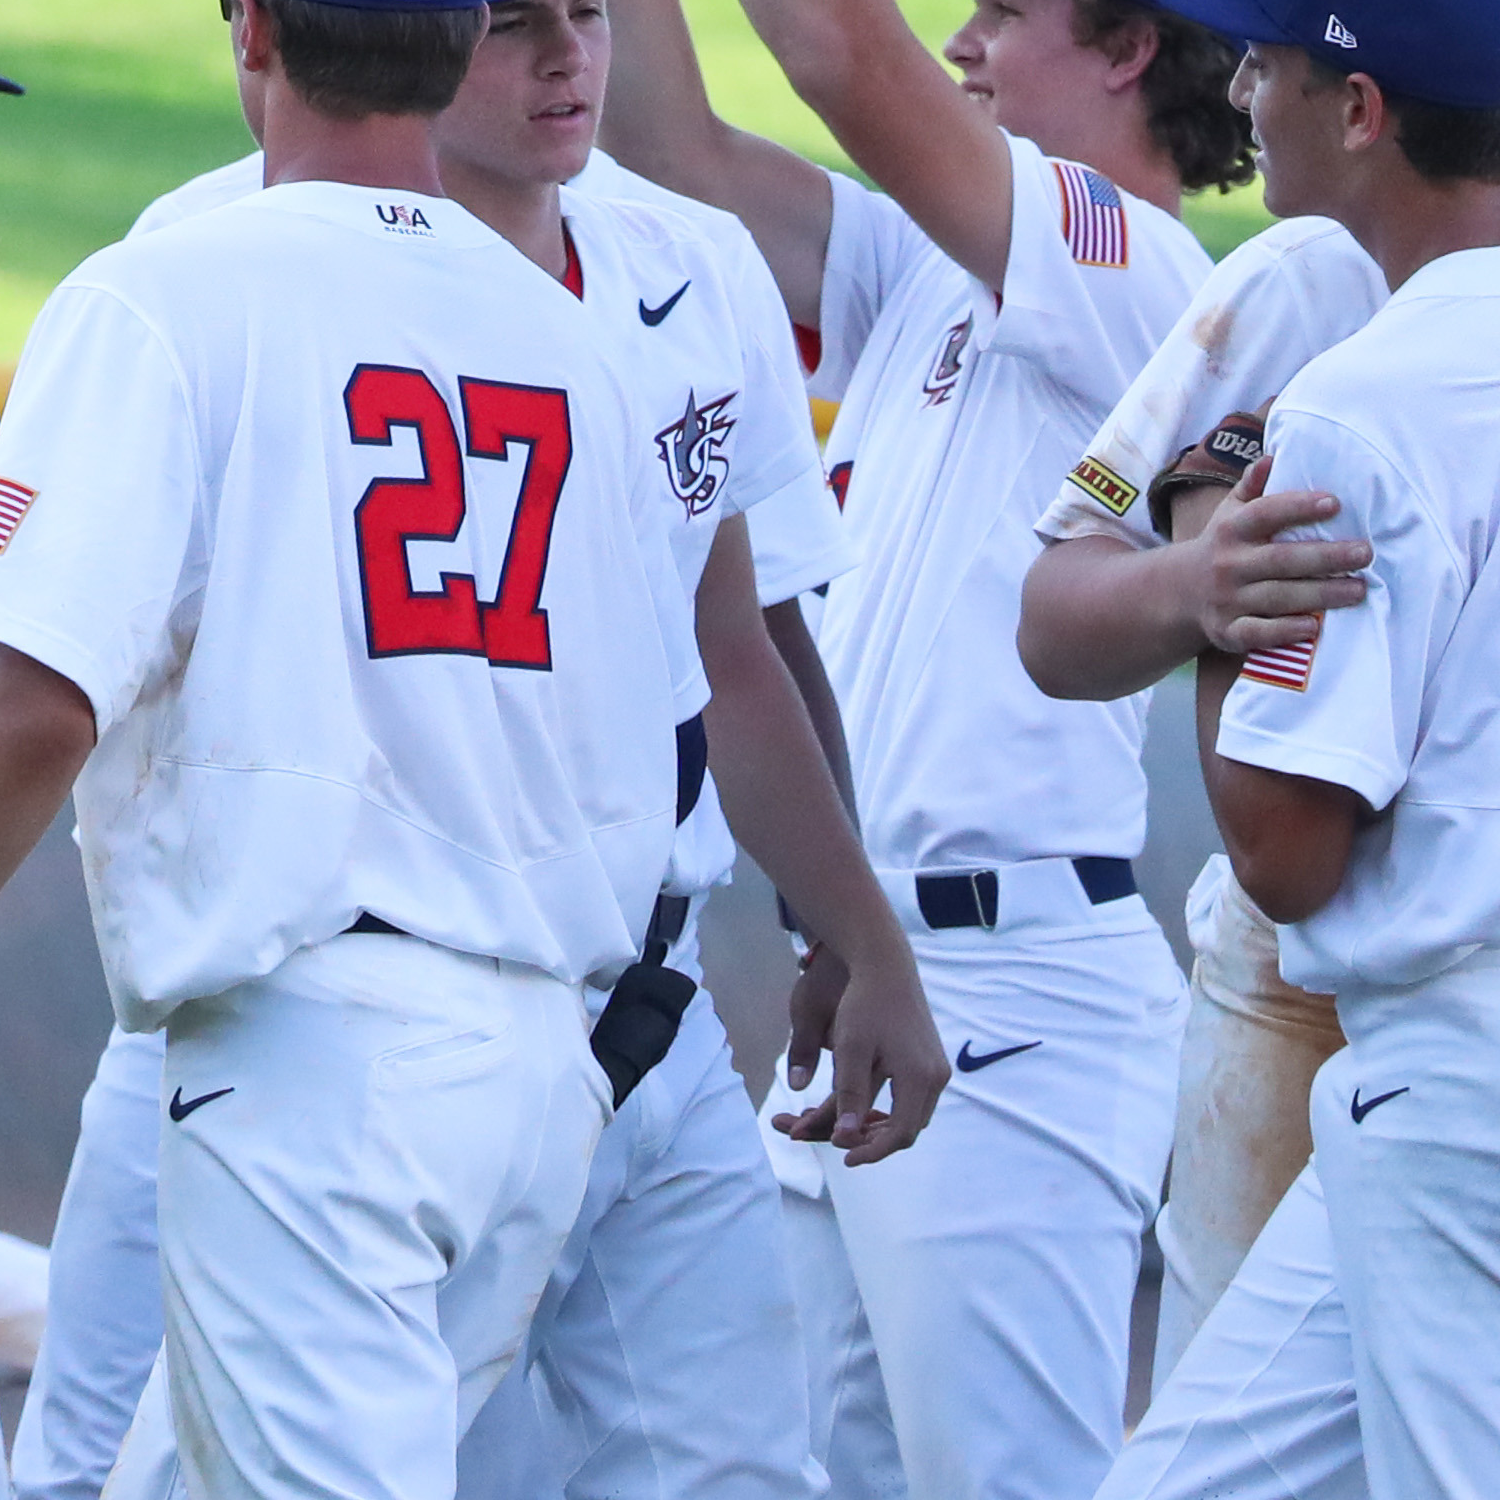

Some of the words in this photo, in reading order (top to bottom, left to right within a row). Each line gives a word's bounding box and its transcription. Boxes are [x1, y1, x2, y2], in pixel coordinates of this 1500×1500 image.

[376, 204, 432, 229] USA
[1071, 461, 1130, 507] ANINI
[343, 363, 572, 672] 27
